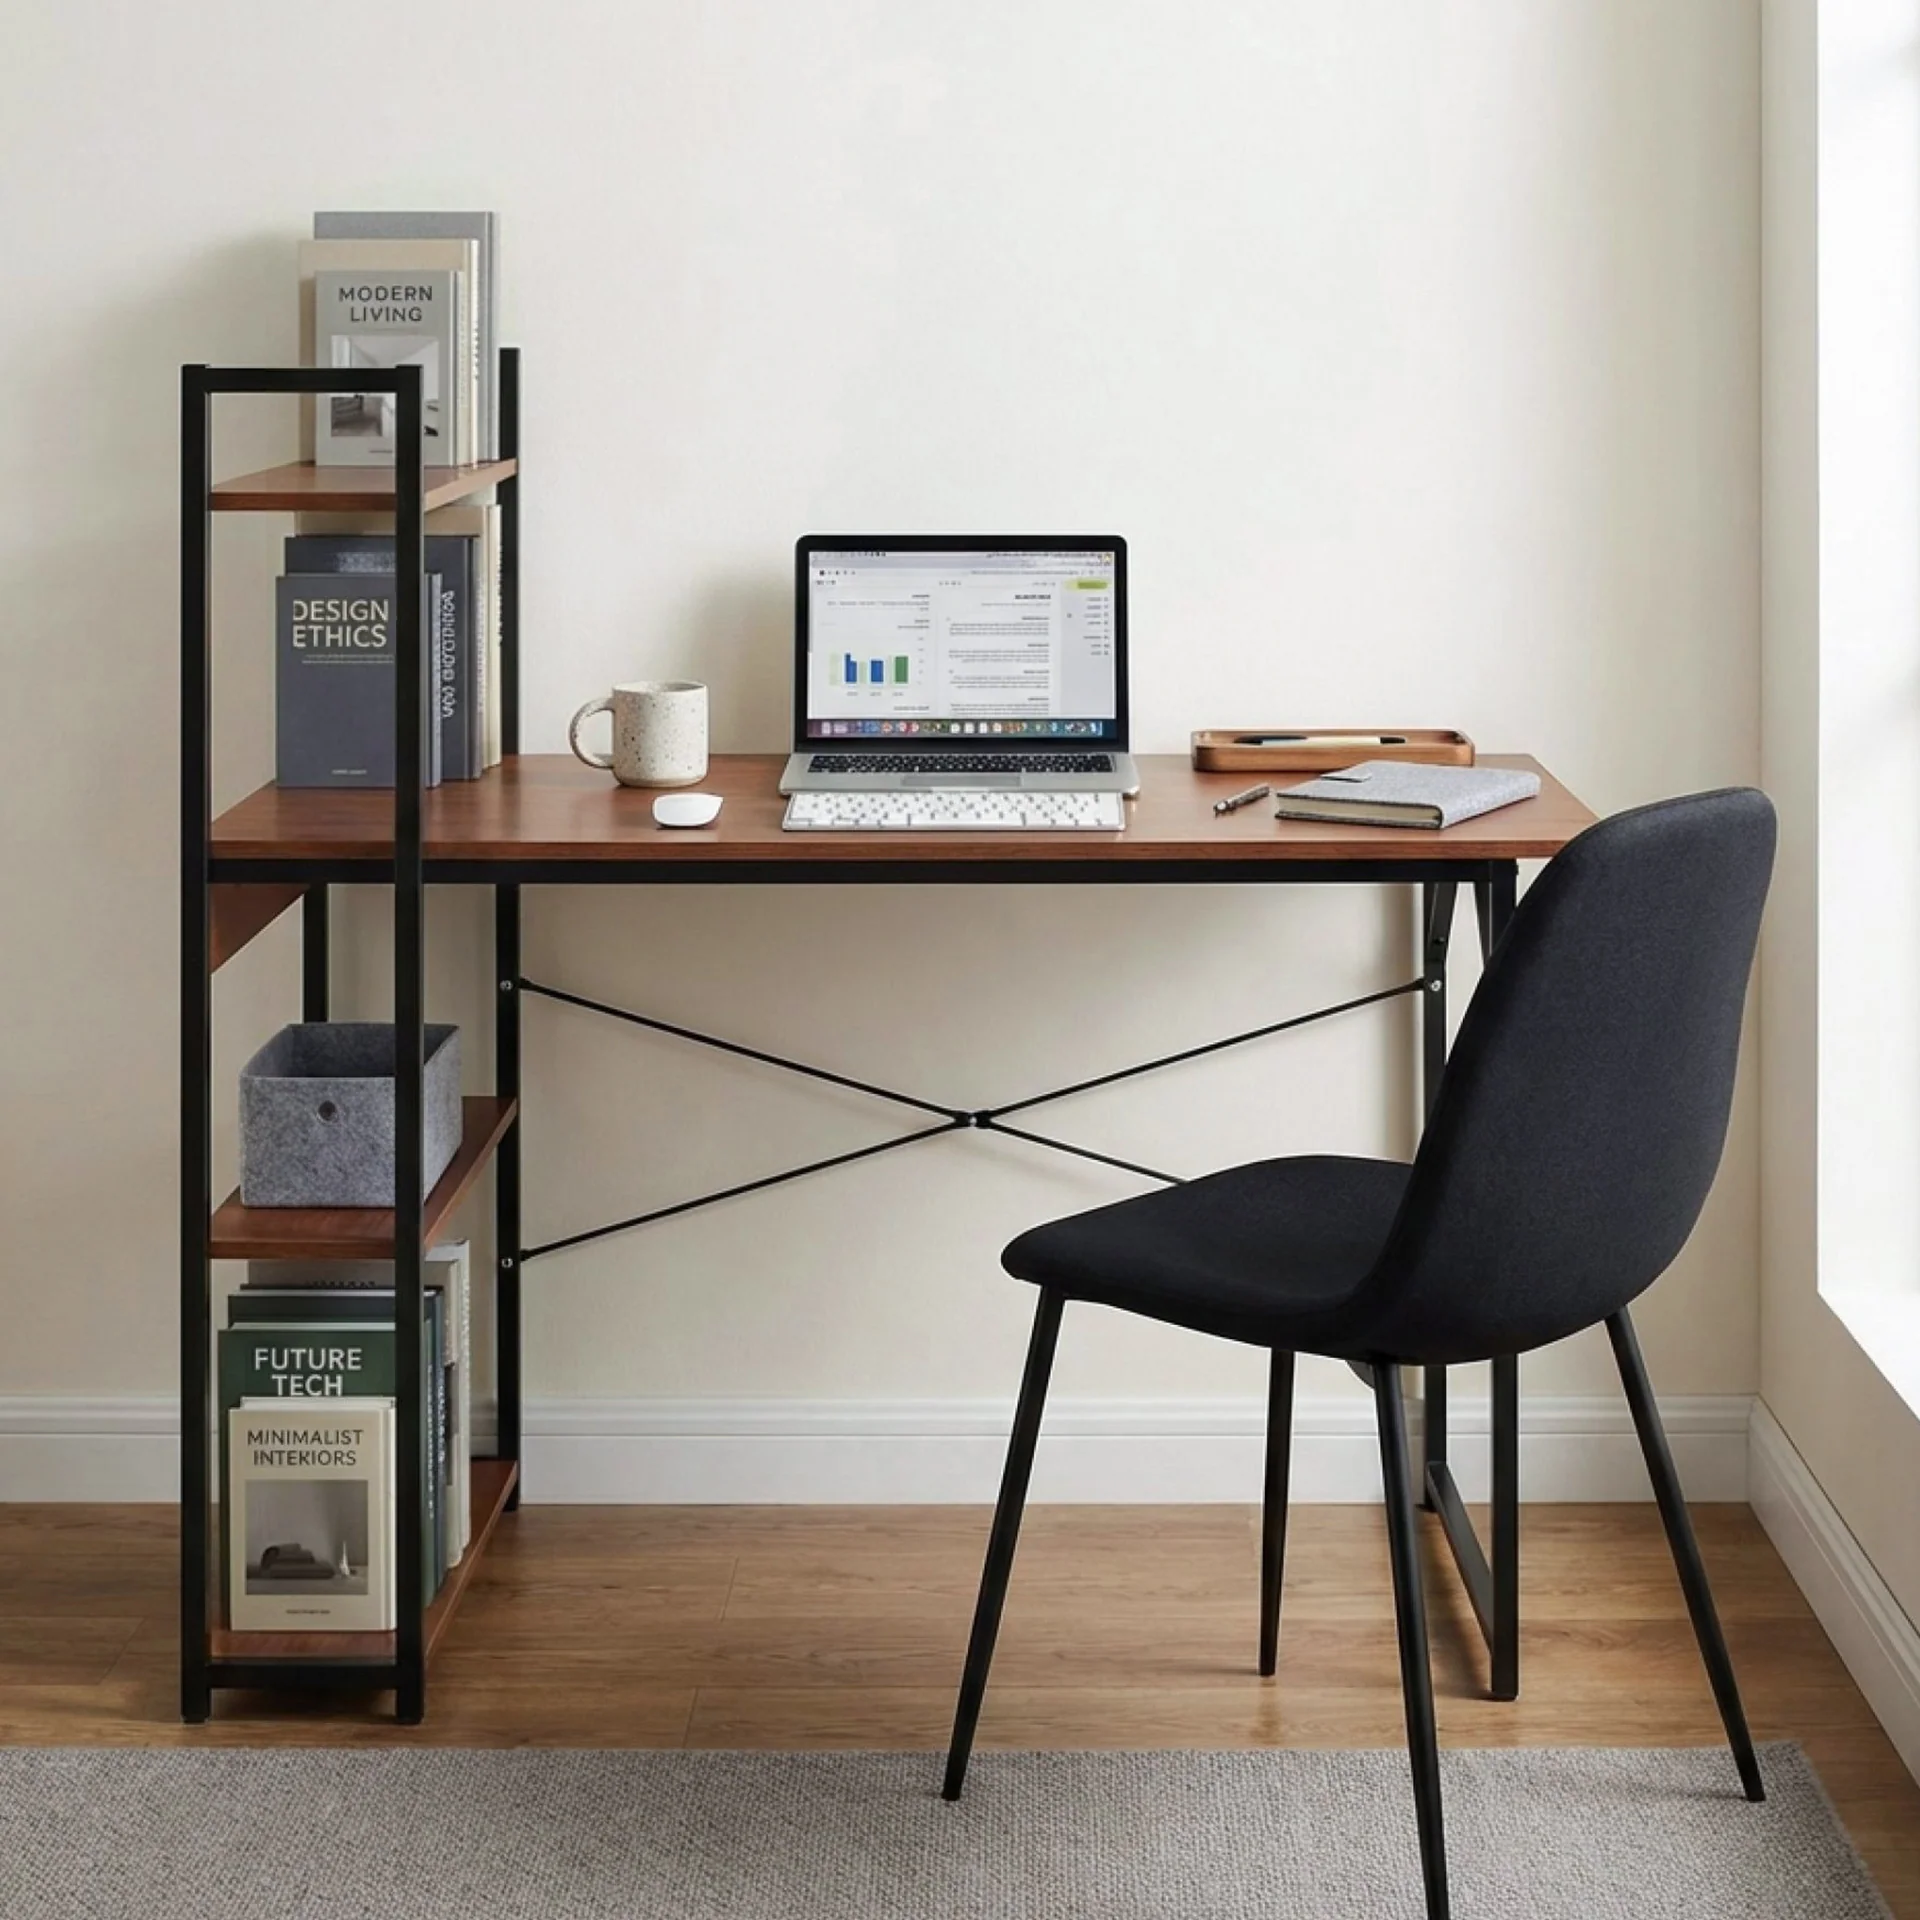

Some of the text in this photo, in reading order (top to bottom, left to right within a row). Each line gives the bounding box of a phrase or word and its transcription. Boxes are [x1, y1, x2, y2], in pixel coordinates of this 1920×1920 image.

[338, 285, 433, 302] MODERN
[350, 306, 423, 322] LIVING
[292, 599, 389, 622] DESIGN
[292, 624, 388, 648] ETHICS
[254, 1347, 363, 1371] FUTURE
[271, 1373, 344, 1397] TECH
[246, 1428, 364, 1446] MINIMALIST
